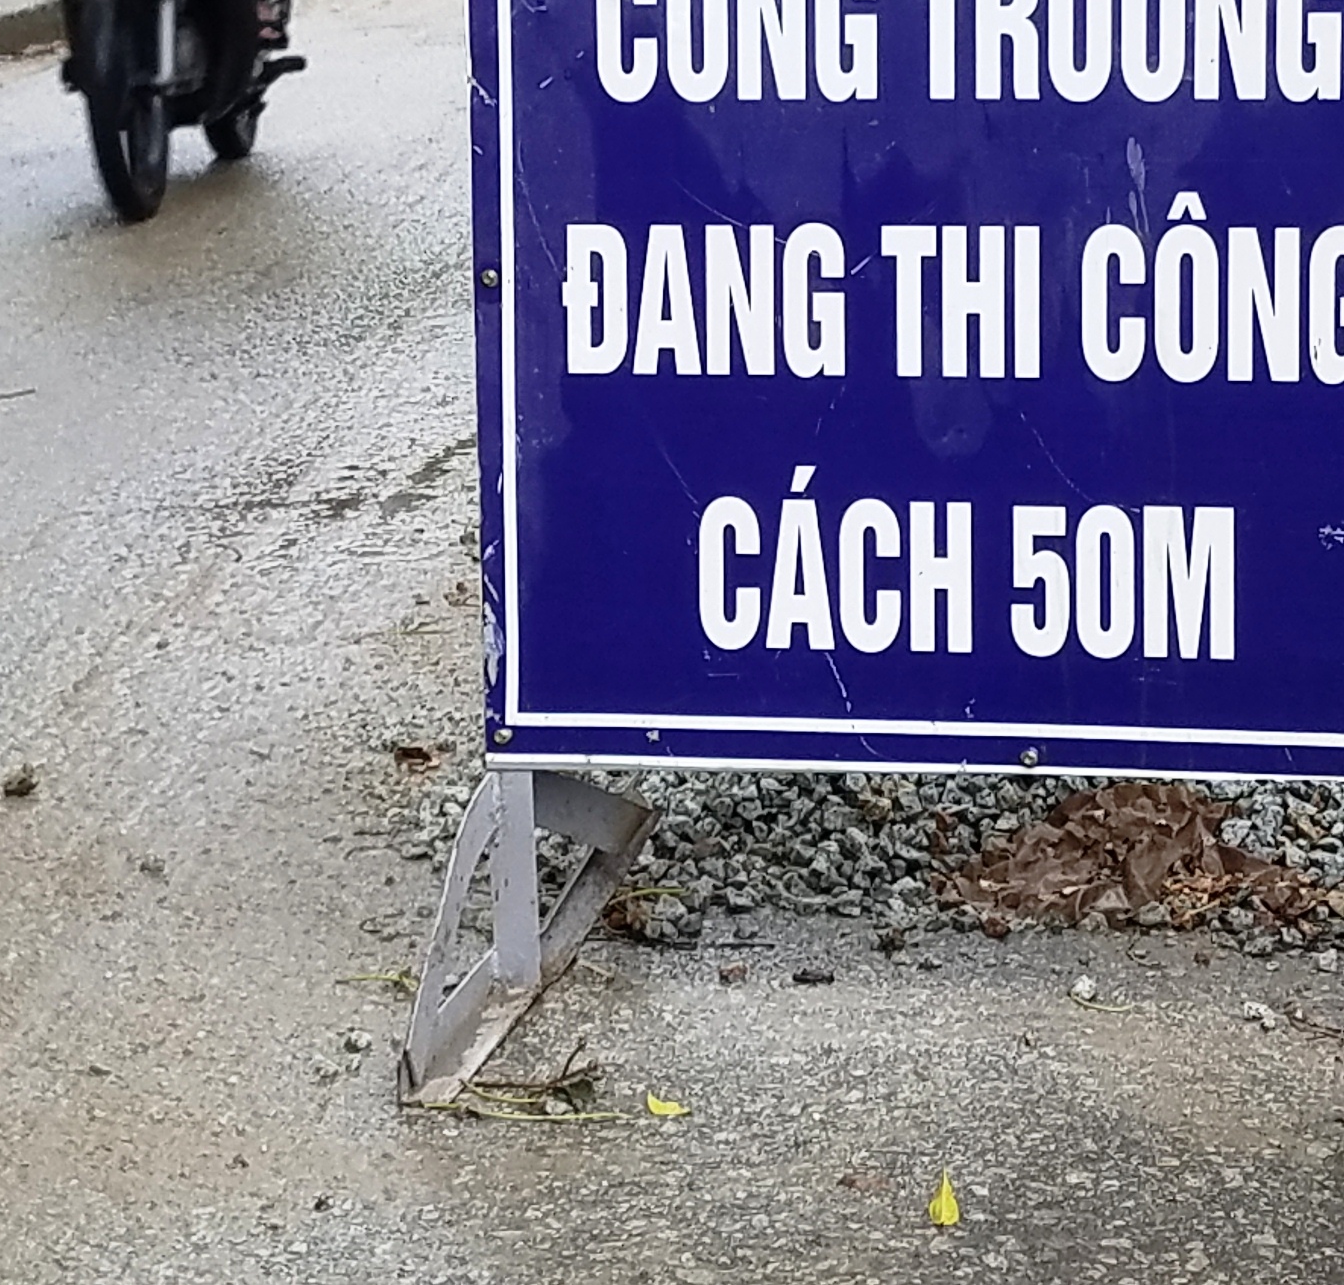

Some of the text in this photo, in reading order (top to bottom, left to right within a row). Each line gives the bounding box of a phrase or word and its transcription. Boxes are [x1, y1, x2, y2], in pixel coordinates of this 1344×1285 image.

[562, 223, 846, 379] ĐANG
[881, 225, 1040, 379] THI
[698, 465, 1235, 660] CÁCH 50M
